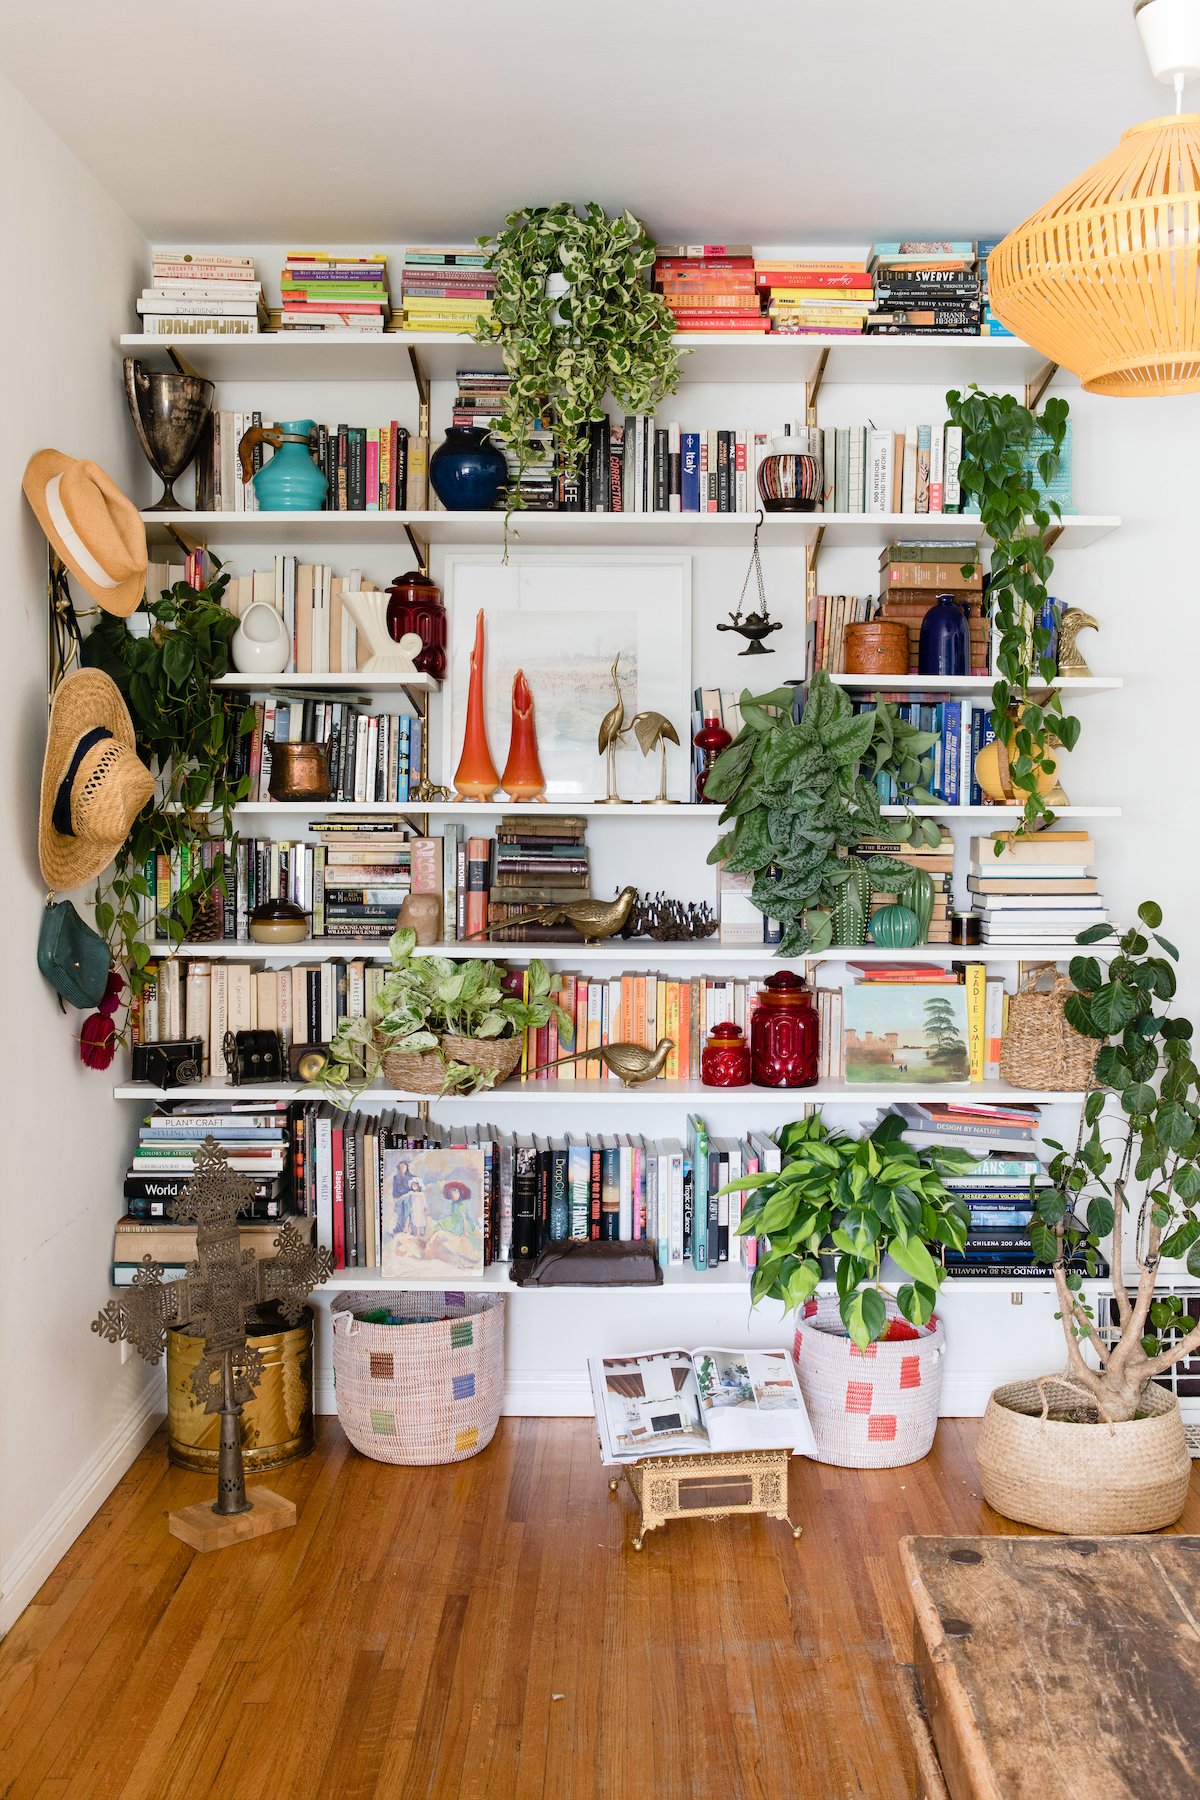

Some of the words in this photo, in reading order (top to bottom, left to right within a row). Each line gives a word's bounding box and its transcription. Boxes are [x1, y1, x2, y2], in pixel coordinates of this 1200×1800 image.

[683, 451, 696, 474] Italy
[947, 446, 959, 500] CHEKHOV
[338, 468, 348, 488] HELL'S
[338, 489, 348, 512] ANGELS
[265, 709, 275, 720] NW
[971, 1024, 979, 1068] SMITH
[321, 1122, 329, 1148] IMAGES
[936, 1123, 962, 1132] DESIGN
[973, 1126, 1001, 1136] NATURE
[144, 1184, 177, 1196] World
[321, 1174, 329, 1200] WORLD
[334, 1169, 343, 1201] Basquiat
[572, 1155, 588, 1204] JONATHAN
[683, 1182, 692, 1202] Tropic
[730, 1194, 739, 1214] DIVERSITY
[572, 1206, 588, 1240] FRANZEN
[683, 1210, 692, 1234] Cancer
[730, 1219, 739, 1227] LIFE
